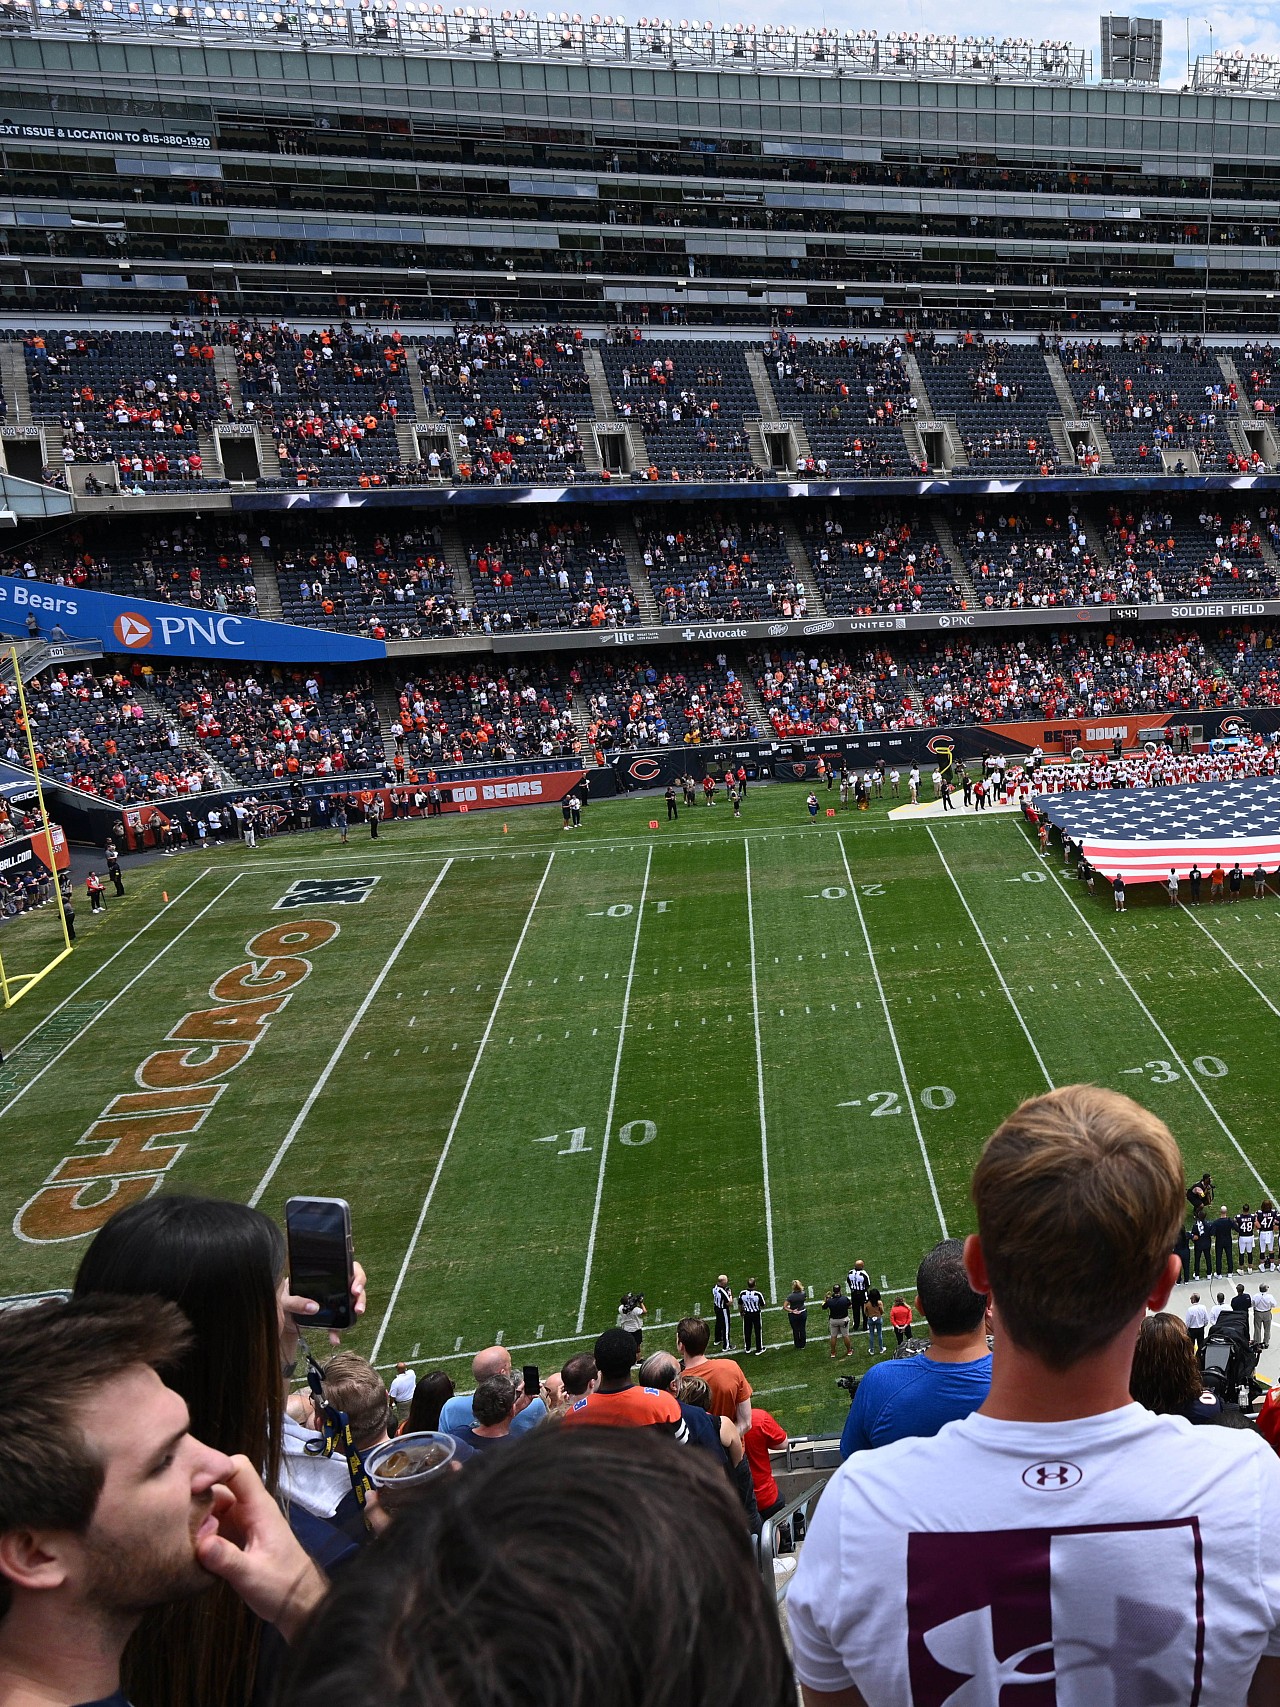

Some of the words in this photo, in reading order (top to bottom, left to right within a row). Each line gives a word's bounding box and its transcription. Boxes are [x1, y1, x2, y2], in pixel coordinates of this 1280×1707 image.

[23, 126, 55, 138] ISSUE
[57, 128, 65, 138] &
[67, 129, 123, 142] LOCATION
[125, 133, 140, 142] TO
[142, 134, 211, 147] 815-880-1920
[2, 427, 15, 435] 302
[25, 427, 38, 435] 303
[219, 425, 231, 433] 303
[240, 425, 252, 433] 304
[416, 424, 427, 432] 304
[435, 424, 446, 432] 305
[13, 586, 78, 615] Bears
[1171, 606, 1224, 617] SOLDIER
[1231, 604, 1265, 615] FIELD
[850, 621, 893, 629] UNITED
[951, 616, 974, 626] PNC
[155, 616, 245, 645] PNC
[697, 628, 747, 640] Advocate
[614, 632, 635, 645] Lite
[51, 648, 64, 656] 101
[1086, 726, 1128, 741] DOWN
[482, 780, 543, 801] BEARS
[1145, 1055, 1229, 1083] 30
[13, 918, 341, 1244] CHICAGO
[866, 1085, 957, 1117] 20
[556, 1119, 658, 1156] 10
[1240, 1220, 1253, 1232] 48
[1260, 1216, 1273, 1228] 47
